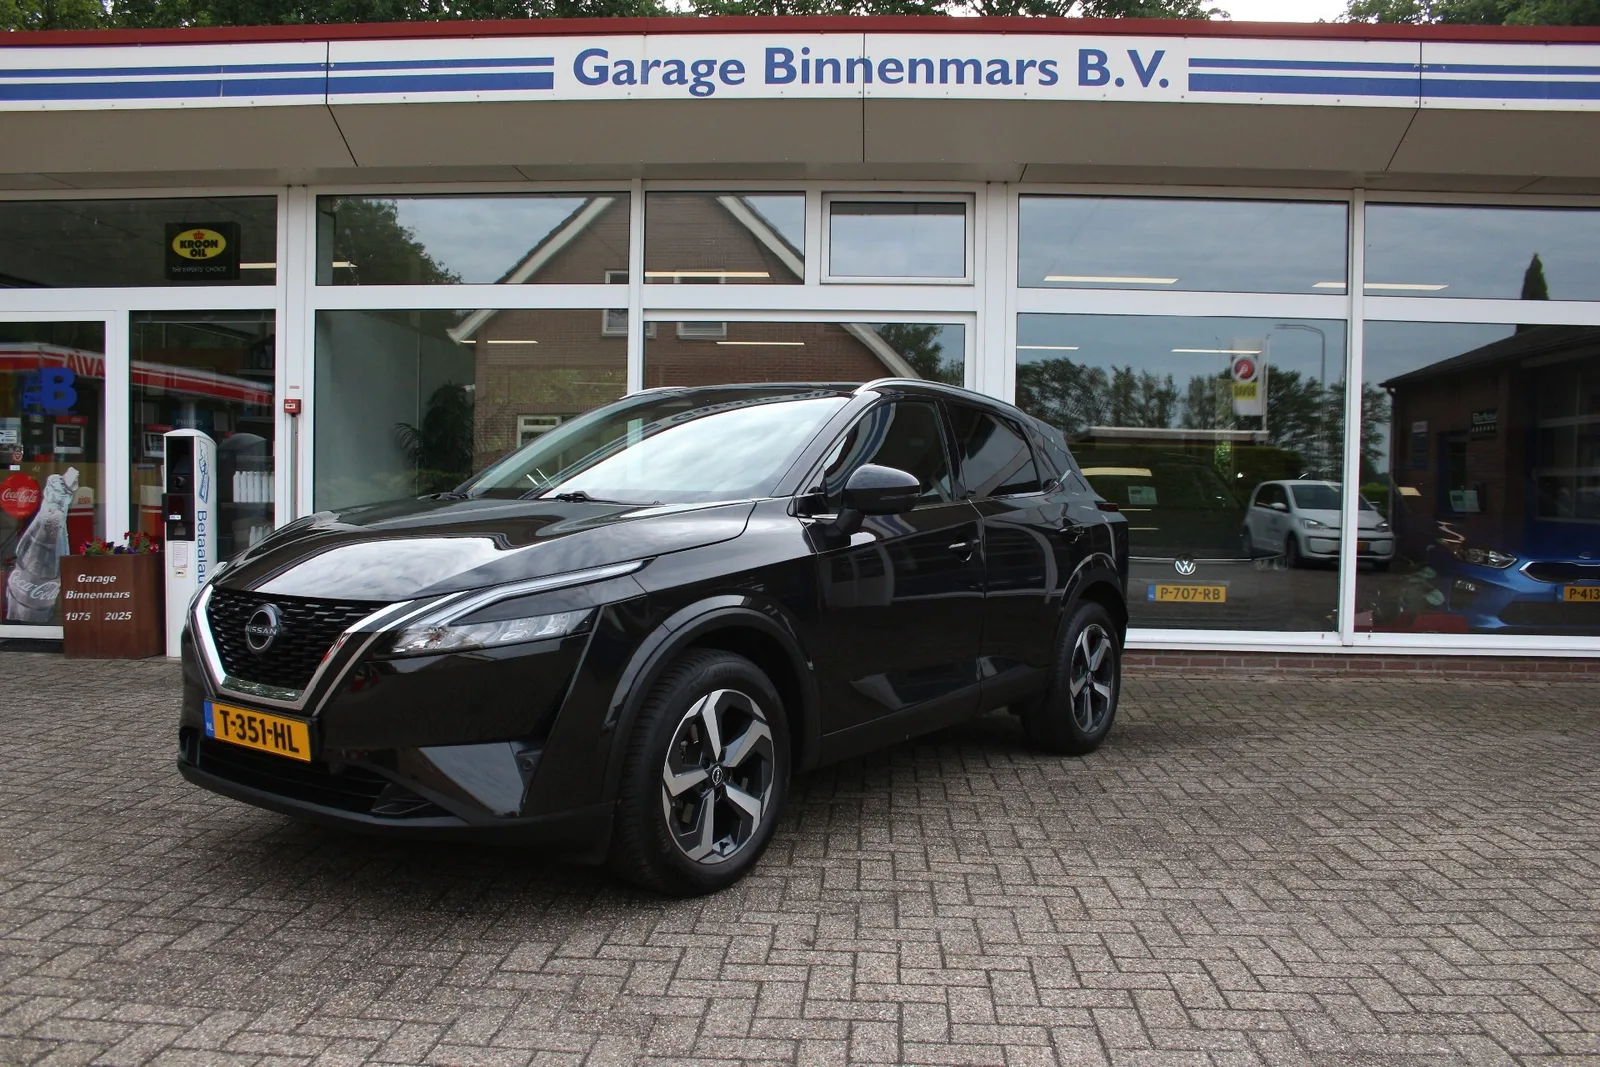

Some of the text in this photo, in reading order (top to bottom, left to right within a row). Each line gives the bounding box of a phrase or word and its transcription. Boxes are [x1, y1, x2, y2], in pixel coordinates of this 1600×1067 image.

[573, 46, 1169, 97] Garage Binnenmars B.V.
[180, 239, 219, 249] KROON
[190, 248, 208, 258] OIL
[77, 573, 117, 585] Garage
[65, 590, 131, 600] Binnenmars
[1160, 587, 1221, 600] P-707-RB
[65, 611, 132, 621] 1975 2025
[206, 709, 300, 754] NL T-351-HL
